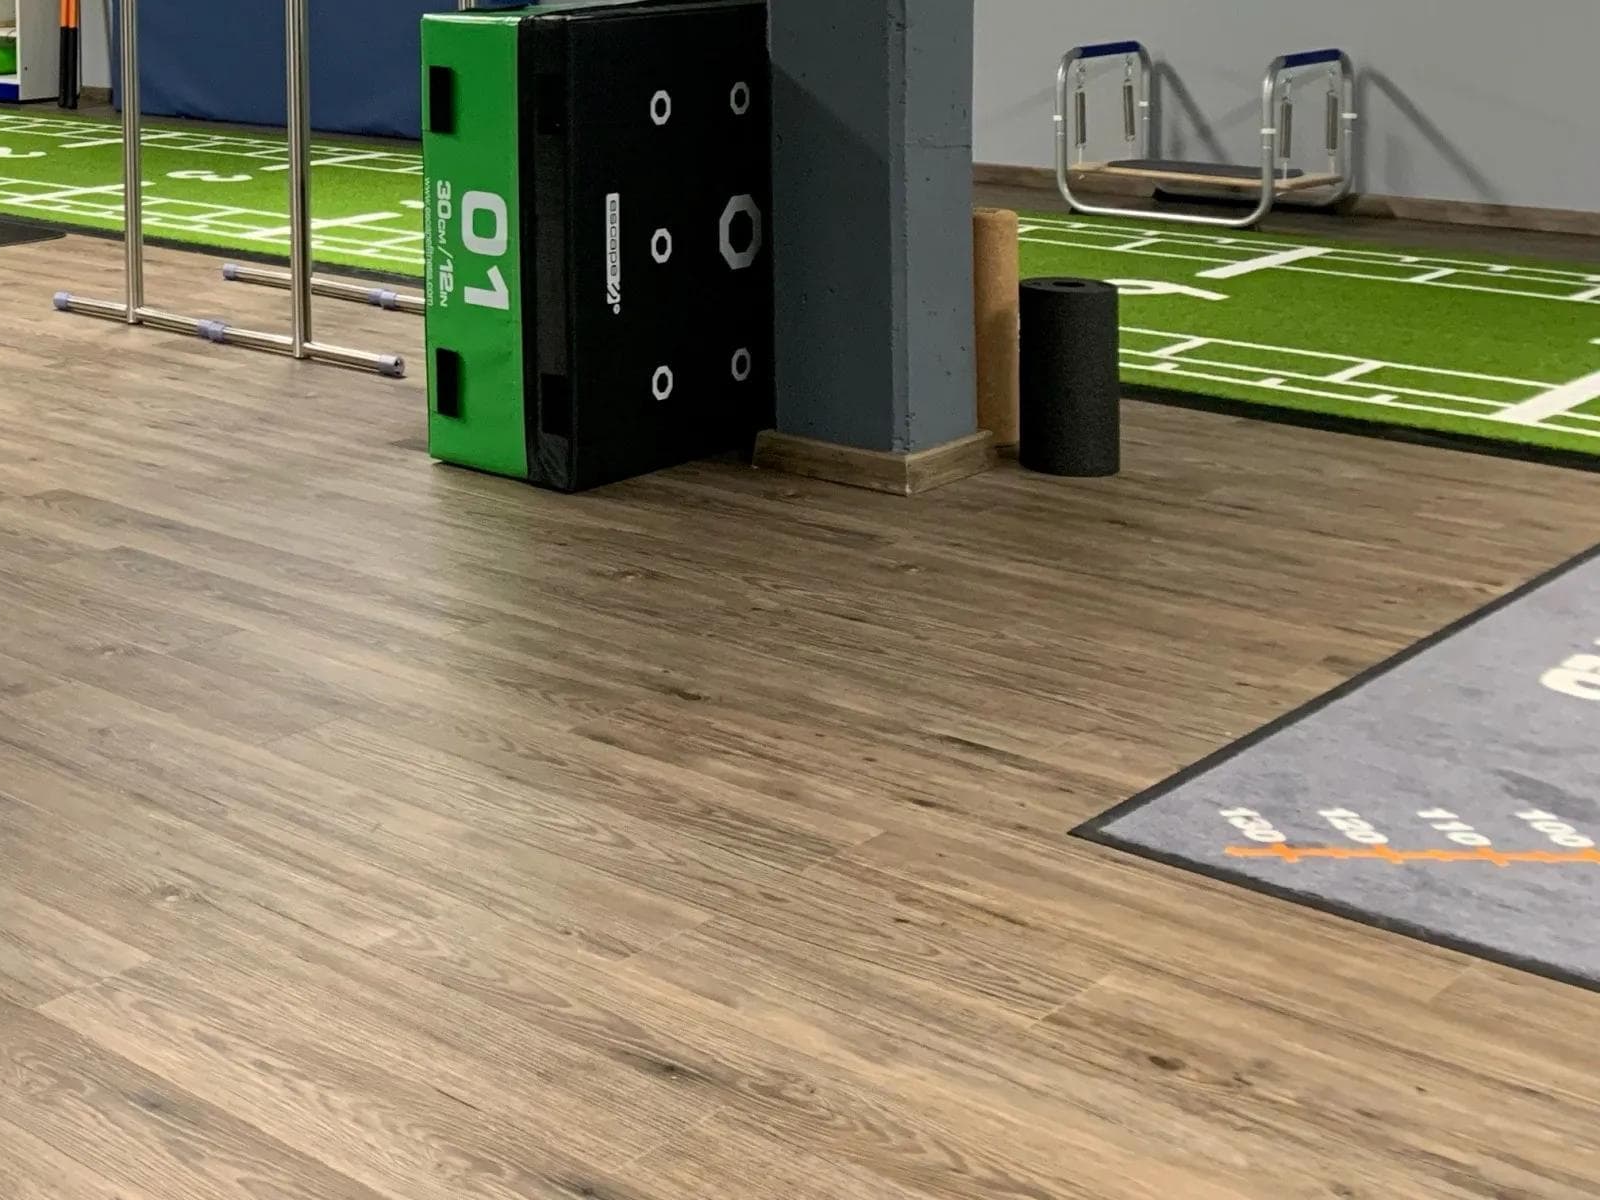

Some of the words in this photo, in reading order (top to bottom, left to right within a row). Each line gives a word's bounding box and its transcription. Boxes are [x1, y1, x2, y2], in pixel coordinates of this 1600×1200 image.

[166, 169, 253, 183] 3
[461, 190, 510, 311] 01
[608, 199, 617, 277] escape
[1416, 807, 1493, 847] 110
[1513, 808, 1596, 848] 100
